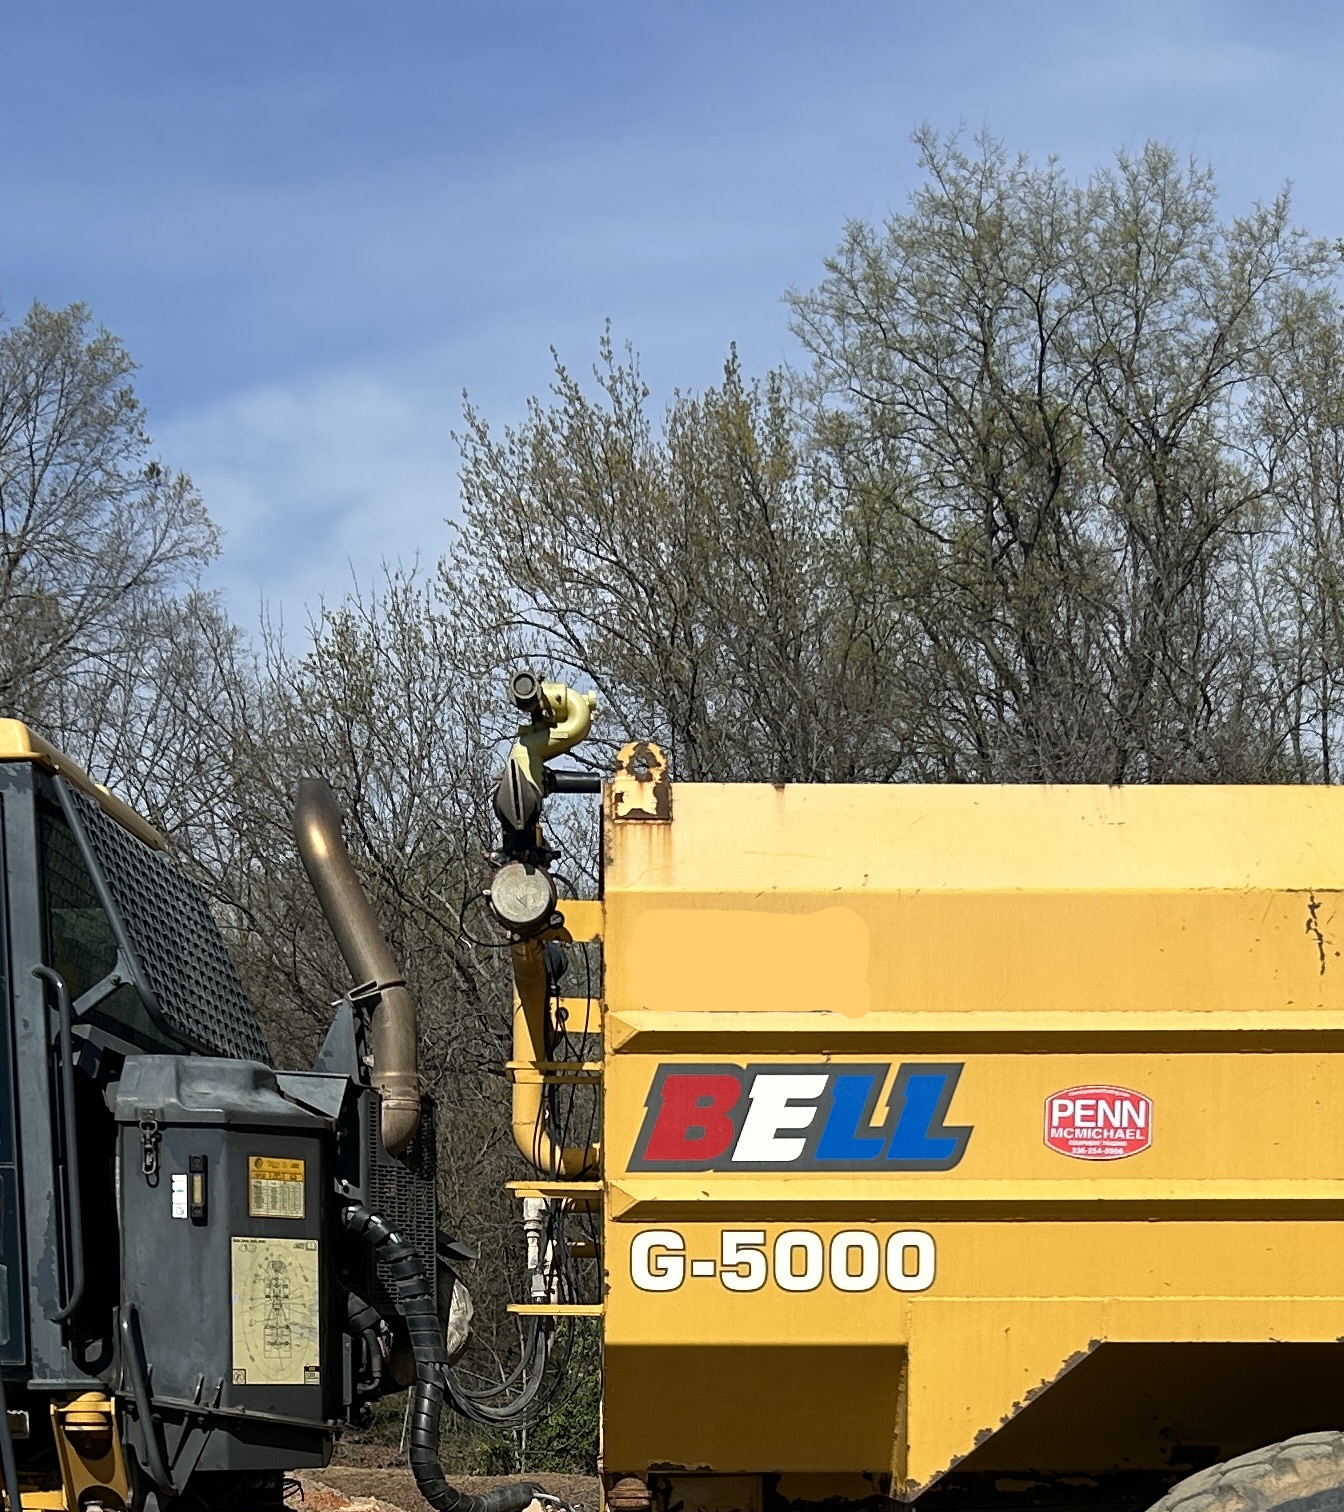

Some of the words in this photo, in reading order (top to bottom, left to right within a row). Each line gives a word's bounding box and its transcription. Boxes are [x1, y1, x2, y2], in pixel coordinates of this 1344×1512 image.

[628, 1064, 972, 1171] BELL
[1050, 1127, 1146, 1140] MCMICHAEL
[1051, 1098, 1146, 1128] PENN
[629, 1229, 938, 1293] G-5000
